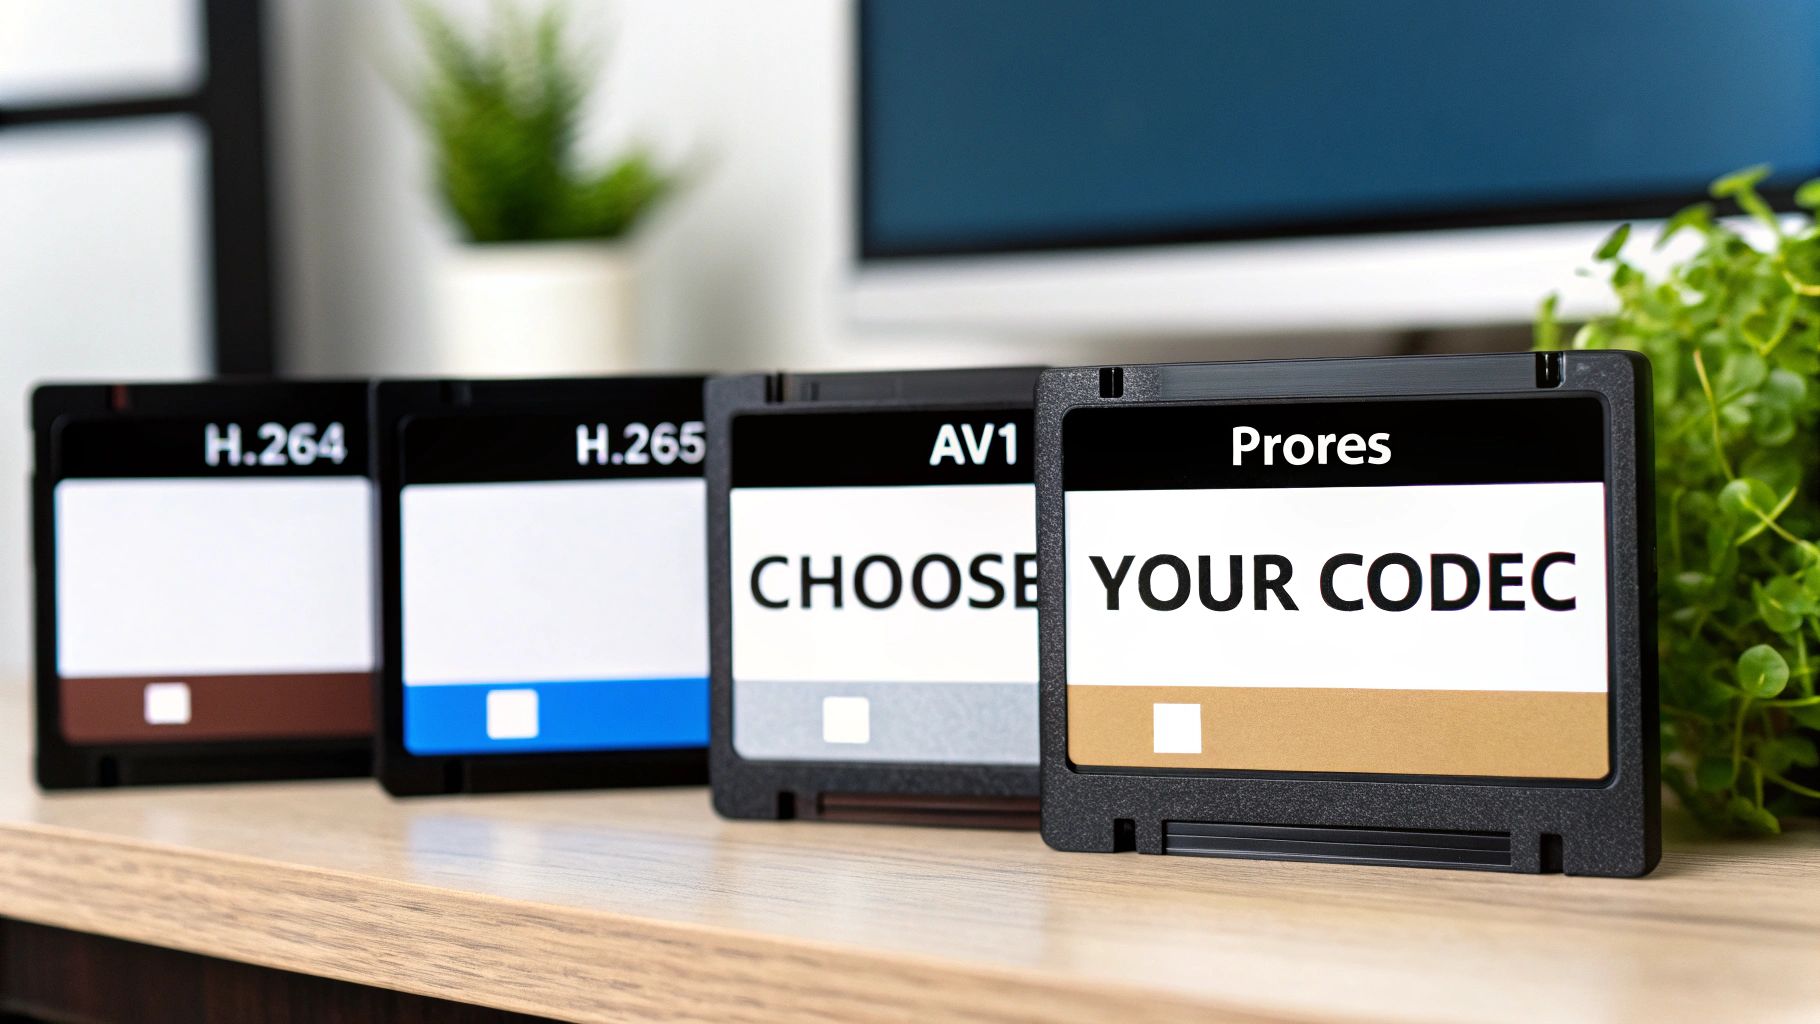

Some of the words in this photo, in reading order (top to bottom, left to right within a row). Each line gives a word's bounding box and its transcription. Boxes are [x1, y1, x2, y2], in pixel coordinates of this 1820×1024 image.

[205, 423, 346, 466] H.264
[576, 421, 706, 465] H.265
[929, 422, 1017, 466] AV1
[1232, 425, 1391, 466] Prores
[750, 552, 1038, 610] CHOOSE
[1089, 553, 1300, 612] YOUR
[1319, 551, 1577, 612] CODEC
